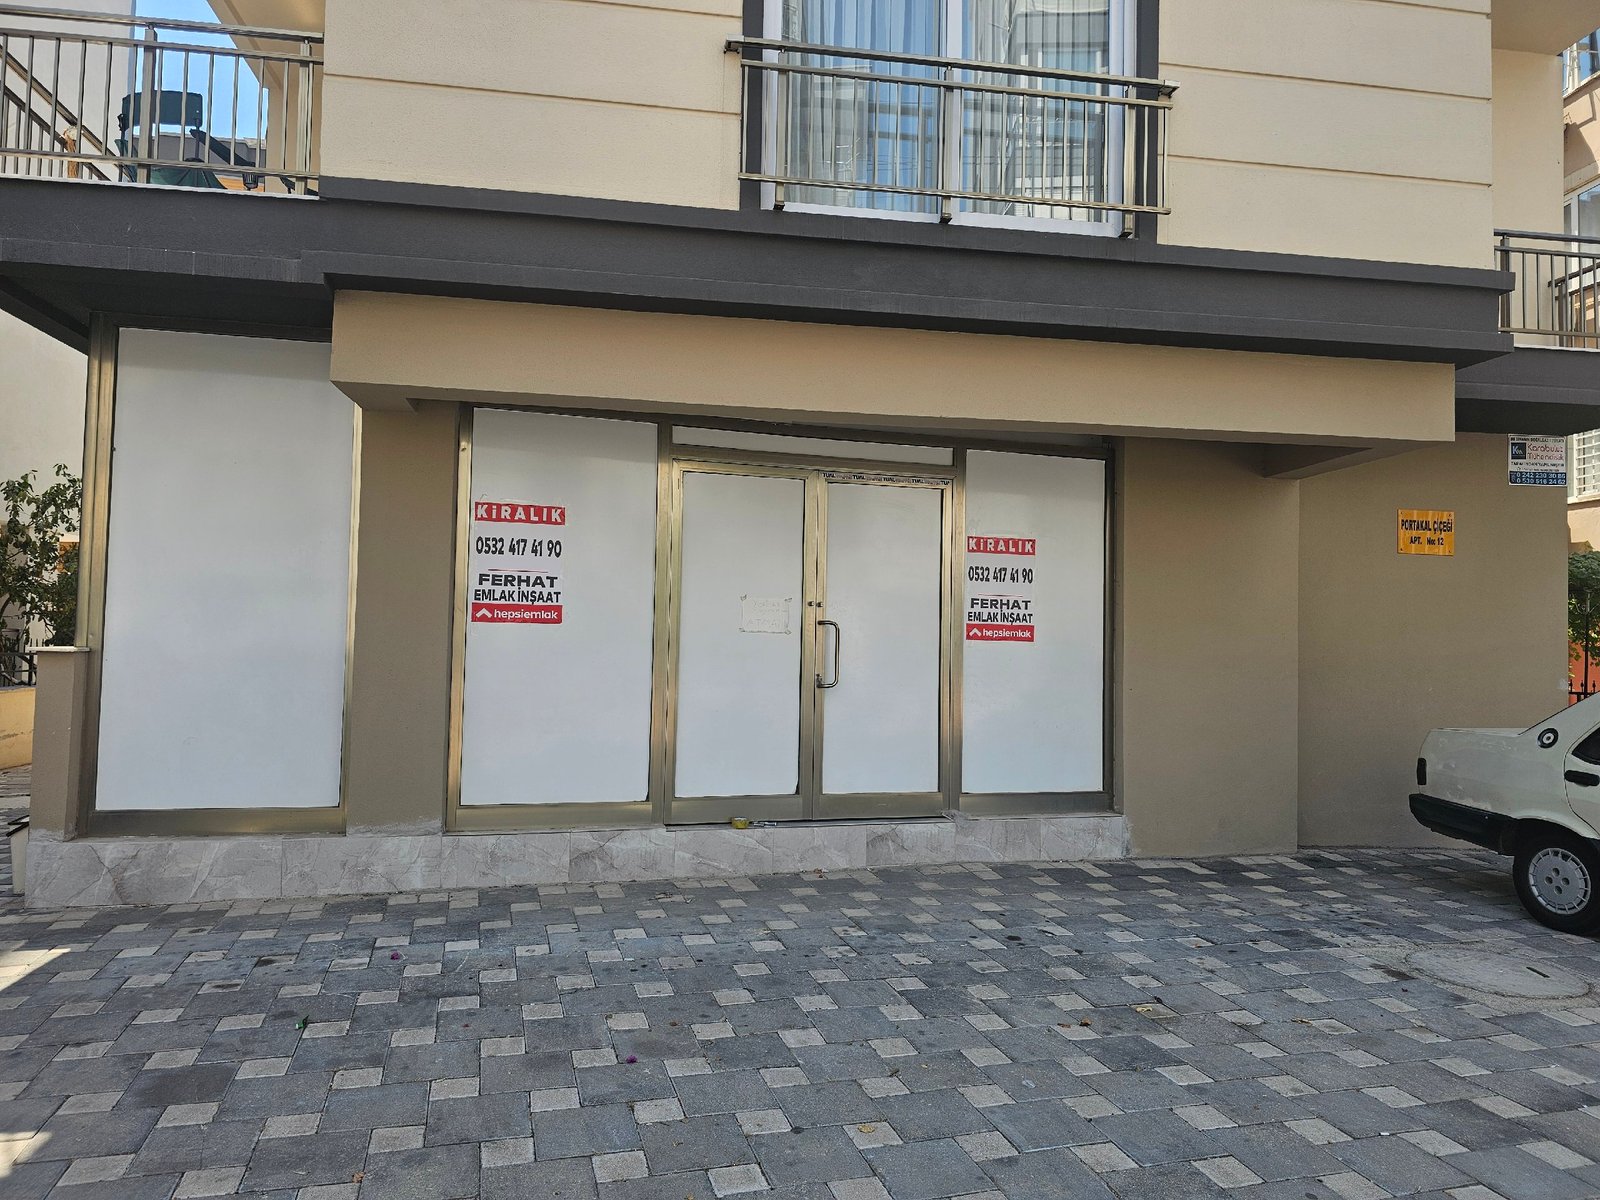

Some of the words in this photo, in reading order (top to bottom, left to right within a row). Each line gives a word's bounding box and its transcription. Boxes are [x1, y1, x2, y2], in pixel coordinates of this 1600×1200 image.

[1401, 519, 1432, 531] PORTAKAL
[476, 536, 505, 555] 0532
[508, 537, 527, 556] 417
[531, 539, 543, 557] 41
[547, 539, 562, 558] 90
[1410, 536, 1422, 544] APT.
[1437, 537, 1444, 545] 12
[478, 573, 558, 588] FERHAT
[968, 565, 990, 582] 0532
[992, 567, 1007, 583] 417
[1010, 568, 1019, 583] 41
[1022, 568, 1033, 584] 90
[474, 588, 515, 602] EMLAK
[517, 586, 561, 605] İNŞAAT
[970, 597, 1031, 610] FERHAT
[494, 608, 558, 620] hepsiemlak
[967, 611, 999, 623] EMLAK
[1000, 609, 1033, 625] İNŞAAT
[982, 628, 1031, 638] hepsiemlak
